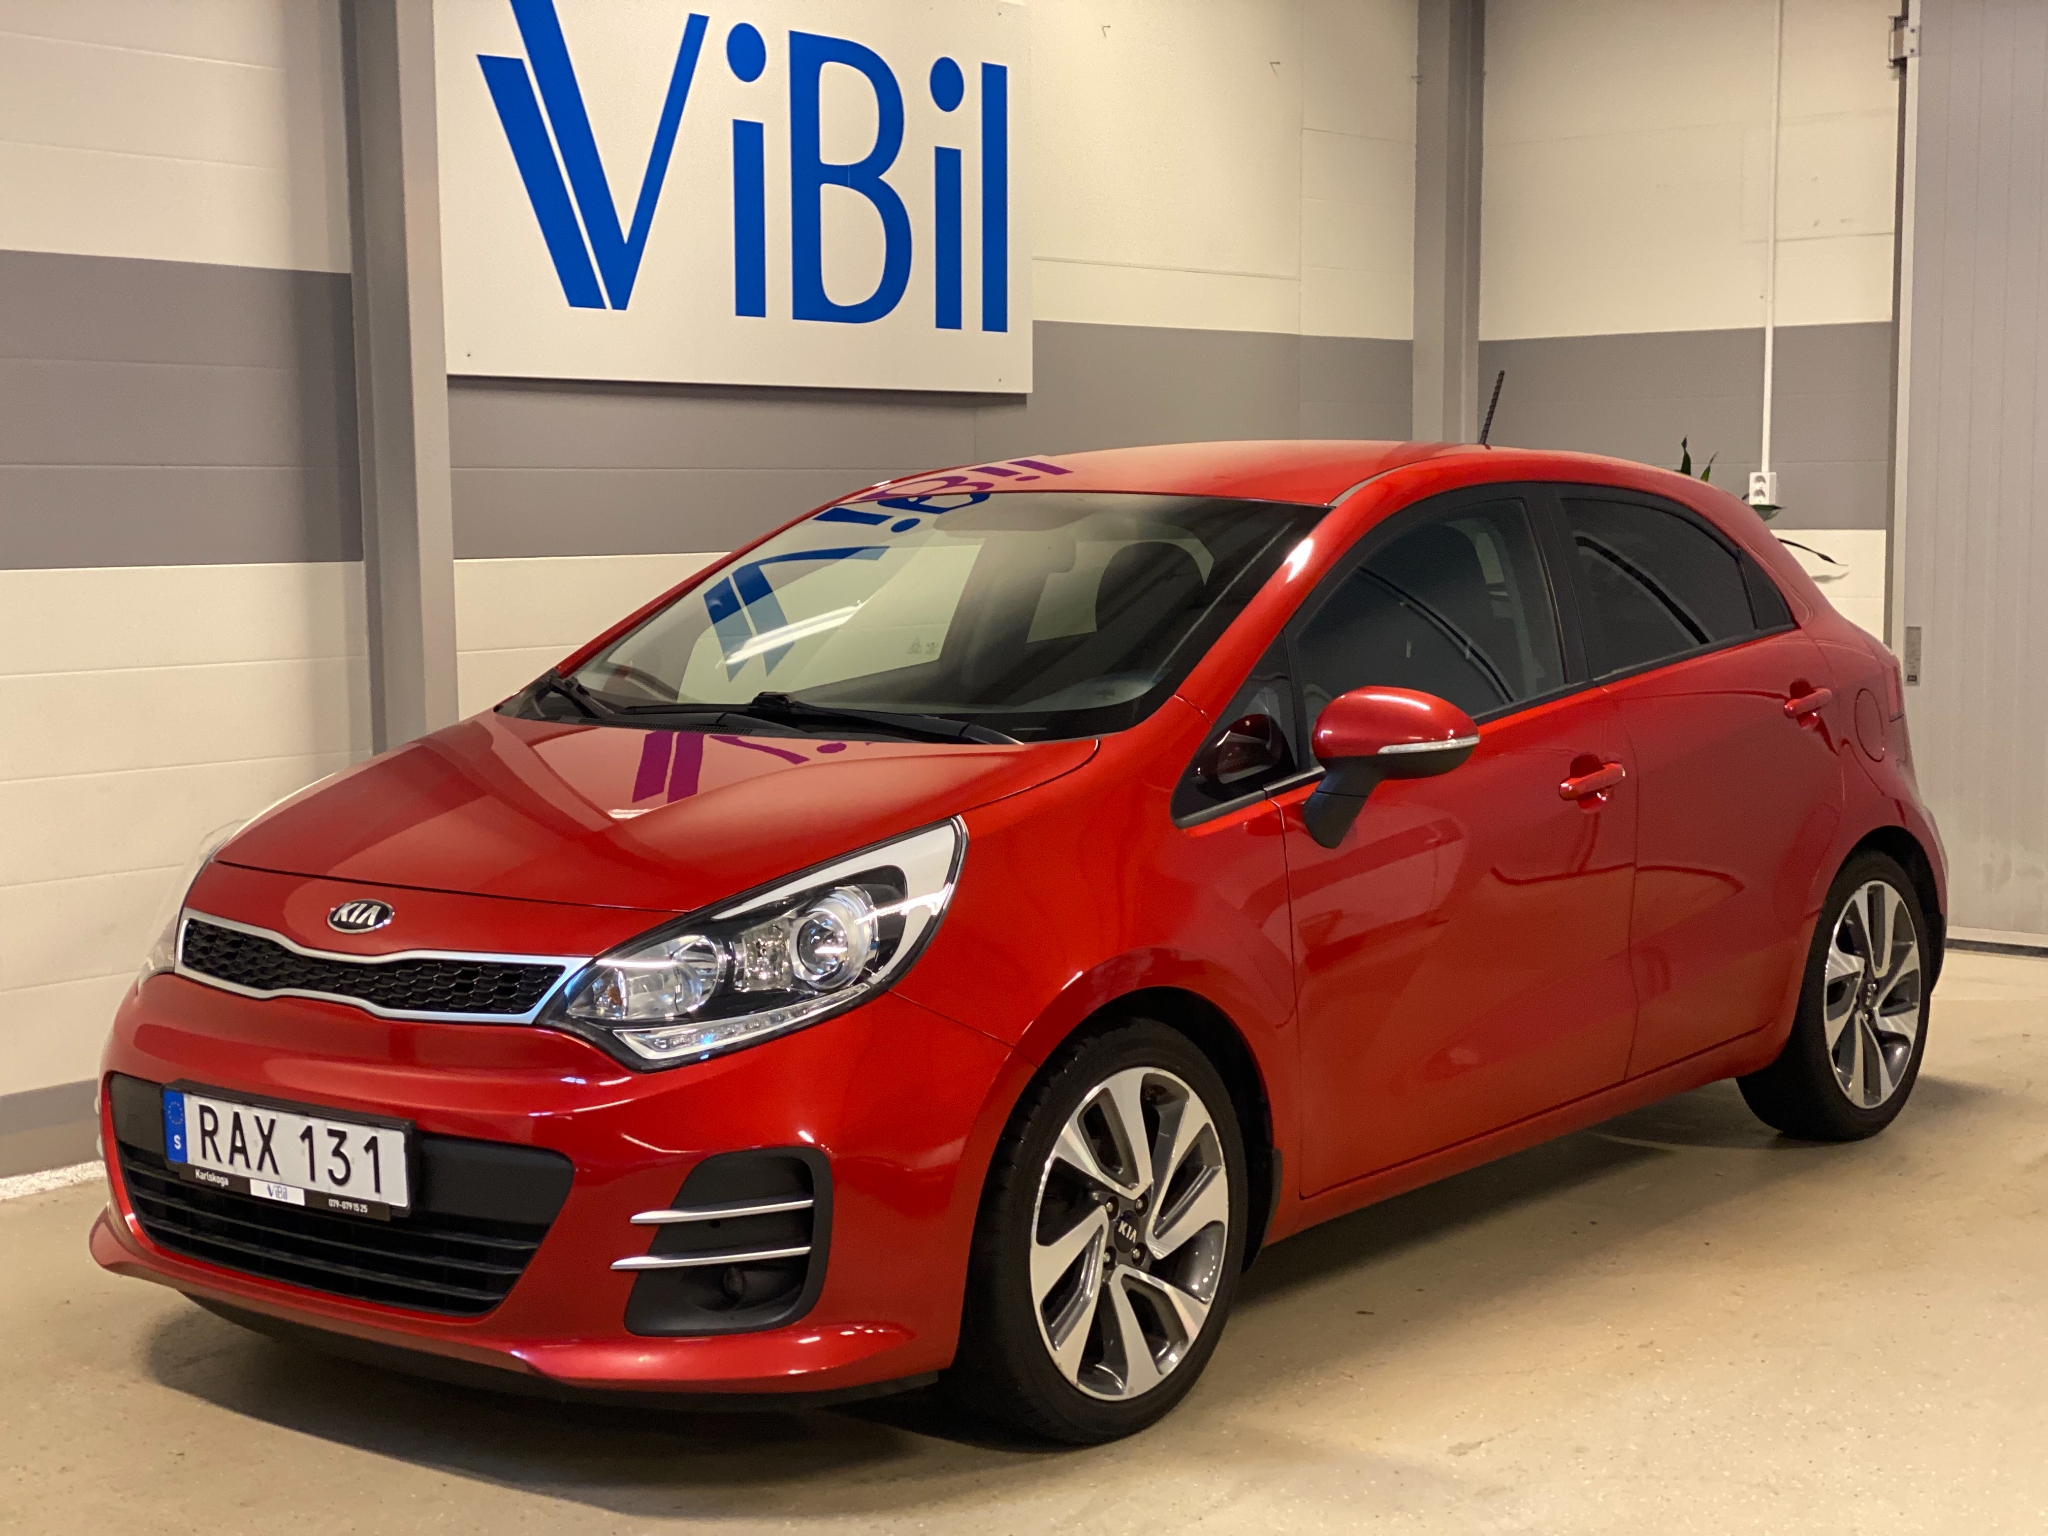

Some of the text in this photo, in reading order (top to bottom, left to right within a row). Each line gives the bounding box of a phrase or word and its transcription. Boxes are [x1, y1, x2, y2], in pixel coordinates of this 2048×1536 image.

[476, 0, 1008, 333] ViBil
[333, 903, 381, 926] KIA
[173, 1134, 182, 1150] S
[198, 1103, 381, 1194] RAX 131
[195, 1169, 229, 1187] Karlskoga
[1118, 1220, 1137, 1243] KIA
